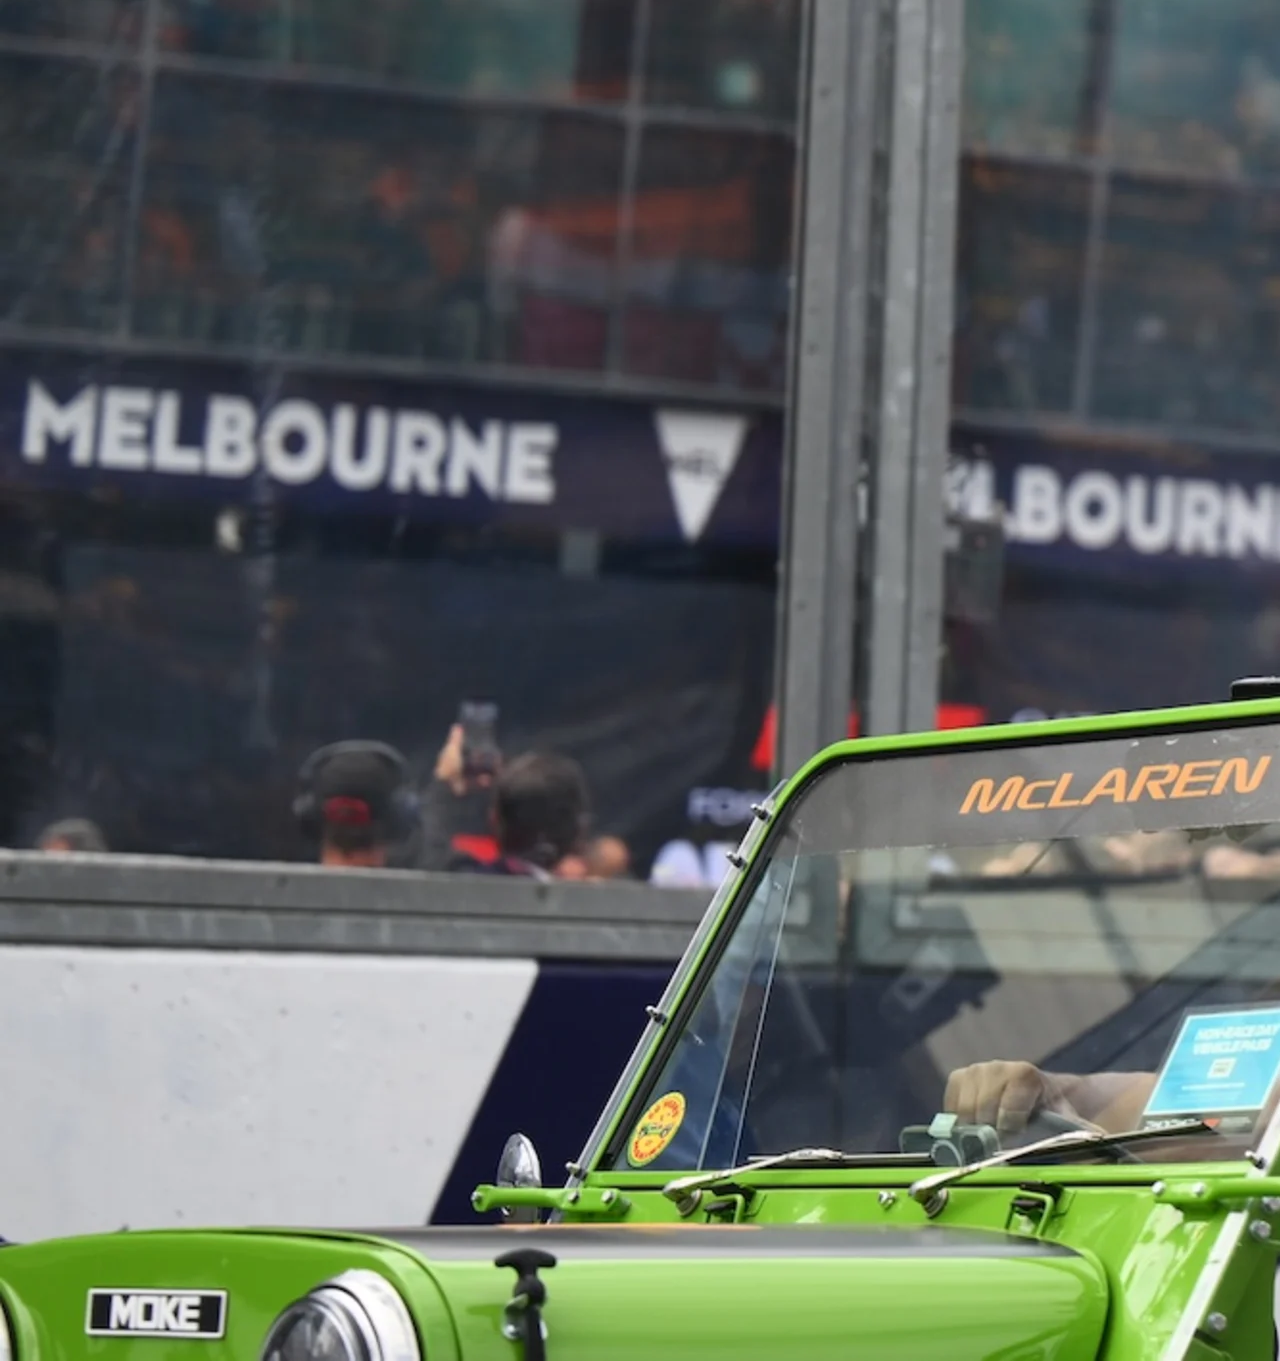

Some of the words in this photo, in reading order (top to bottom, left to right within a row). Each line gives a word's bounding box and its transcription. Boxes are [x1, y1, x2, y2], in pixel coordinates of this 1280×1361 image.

[21, 378, 558, 505] MELBOURNE
[958, 754, 1272, 816] McLAREN
[110, 1294, 201, 1332] MOKE
